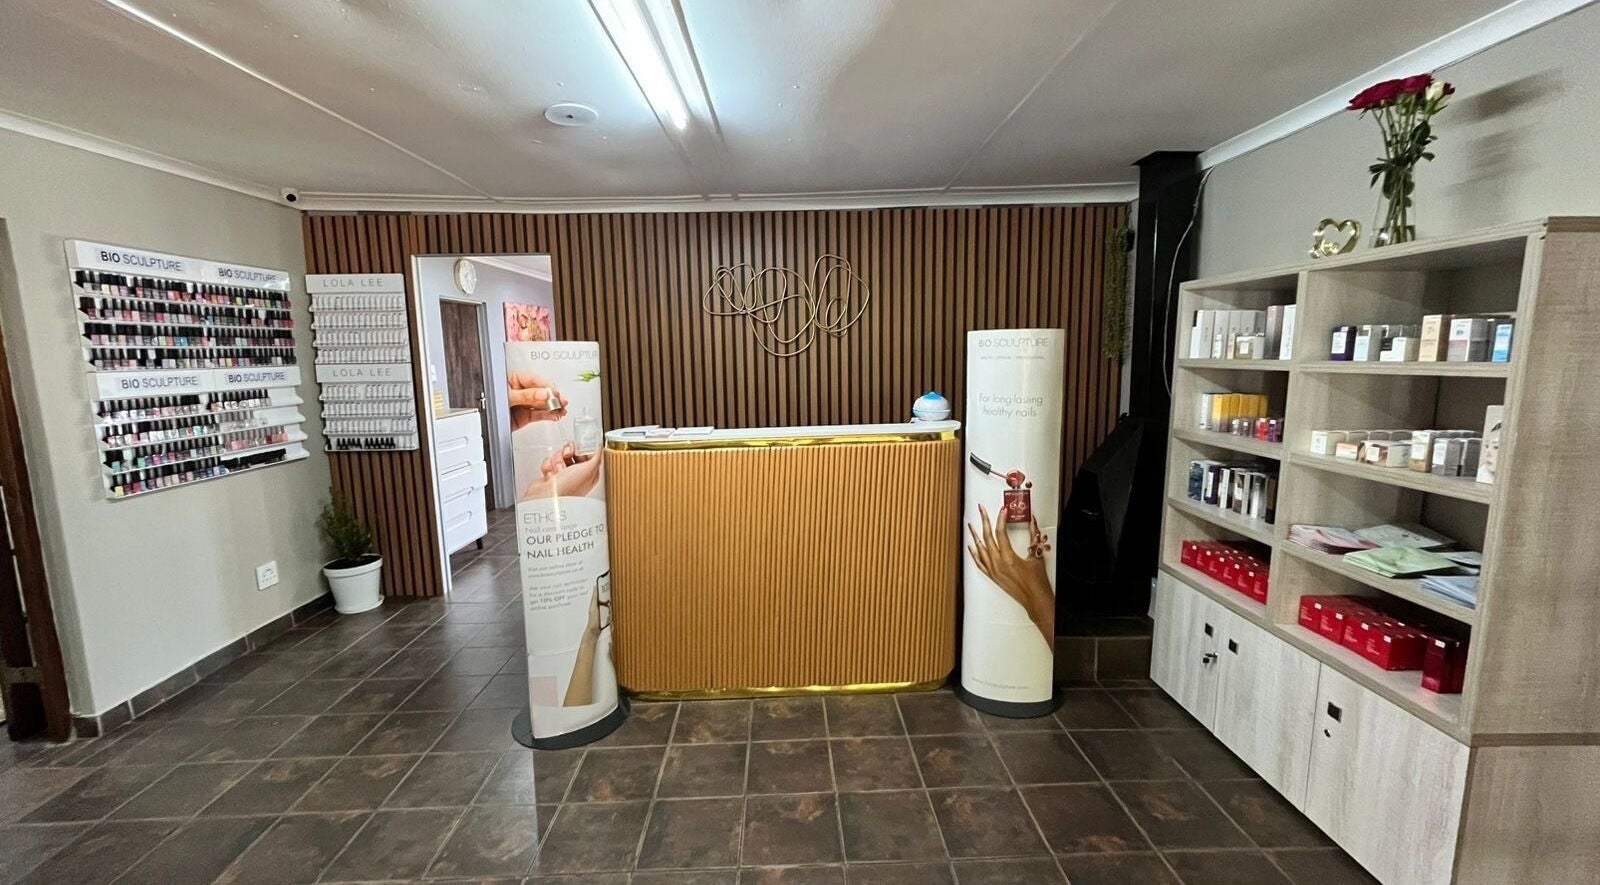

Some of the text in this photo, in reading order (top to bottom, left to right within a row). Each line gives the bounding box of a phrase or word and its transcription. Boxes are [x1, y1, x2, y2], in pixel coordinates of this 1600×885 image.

[101, 250, 182, 272] BIO SCULPTURE
[218, 267, 232, 278] BIO
[323, 278, 384, 288] LOLA LEE
[993, 337, 1049, 348] SCULPTURE
[530, 350, 598, 360] BIO SCULPTUR
[228, 371, 285, 383] BIO SCULPTURE
[332, 367, 392, 377] LOLA LEE
[121, 376, 198, 389] BIO SCULPTURE
[979, 392, 991, 403] For
[983, 405, 1037, 418] healthy nails
[526, 523, 605, 545] OUR PLEDGE TO
[527, 541, 594, 559] NAIL HEALTH
